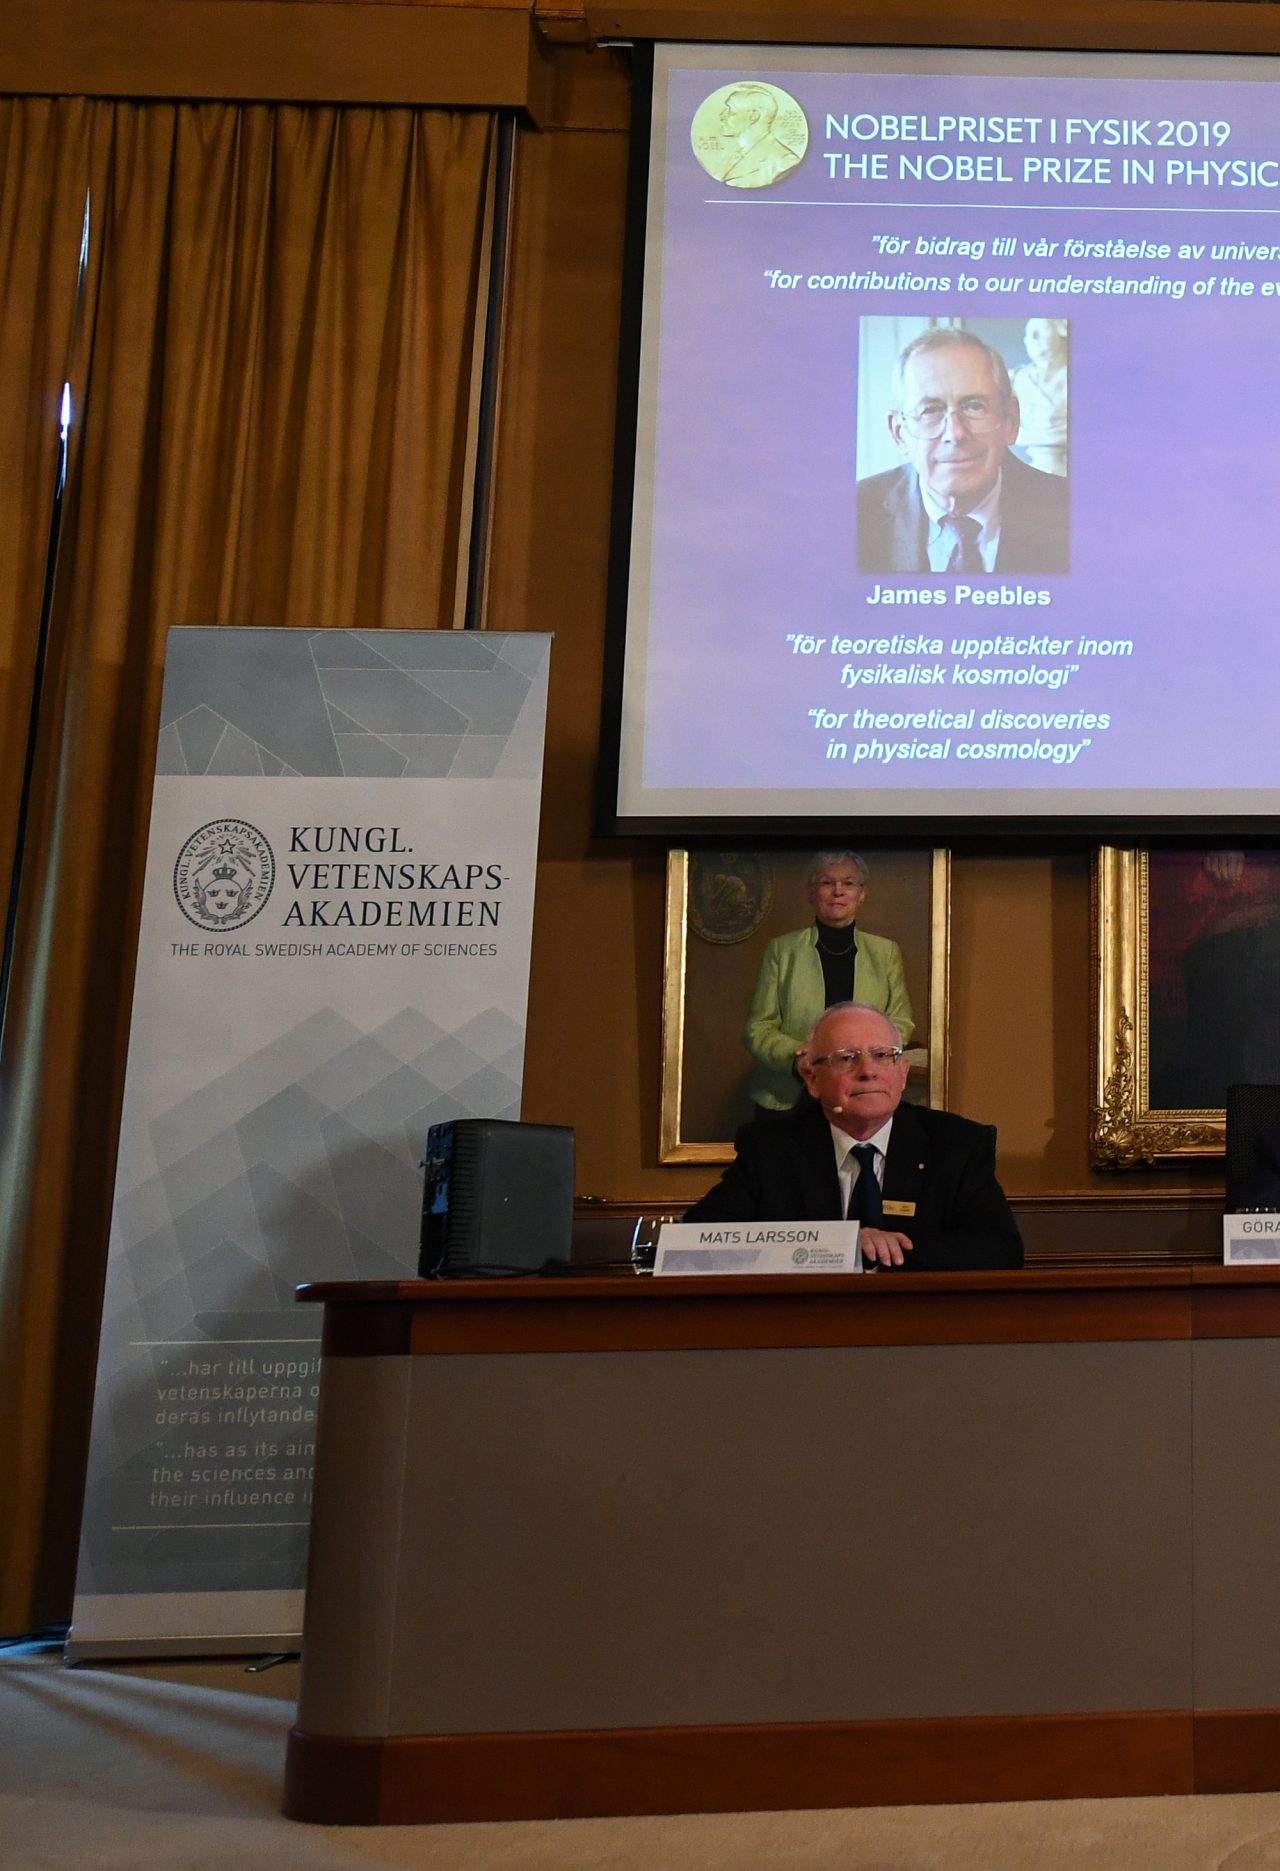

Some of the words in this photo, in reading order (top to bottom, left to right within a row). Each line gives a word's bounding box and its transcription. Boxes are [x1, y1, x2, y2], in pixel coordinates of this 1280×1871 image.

[826, 114, 1043, 143] NOBELPRISET
[1051, 118, 1056, 143] I
[1066, 119, 1152, 145] FYSIK
[1157, 120, 1231, 147] 2019
[823, 153, 888, 179] THE
[900, 155, 1013, 182] NOBEL
[1024, 157, 1111, 183] PRIZE
[1123, 159, 1154, 184] IN
[915, 236, 985, 260] bidrag
[992, 238, 1017, 256] till
[1023, 238, 1059, 257] vår
[1064, 239, 1171, 258] förståelse
[1178, 245, 1206, 259] av
[808, 271, 951, 291] contributions
[958, 273, 979, 291] to
[985, 278, 1024, 292] our
[1028, 275, 1186, 299] understanding
[1193, 277, 1217, 295] of
[1220, 277, 1255, 296] the
[866, 585, 947, 604] James
[955, 585, 1051, 605] Peebles
[831, 634, 943, 654] teoretiska
[951, 635, 1074, 659] upptäckter
[1077, 636, 1133, 655] inom
[841, 664, 947, 688] fysikalisk
[853, 709, 975, 729] theoretical
[980, 709, 1110, 729] discoveries
[826, 738, 847, 759] in
[853, 738, 951, 764] physical
[289, 827, 413, 852] KUNGL.
[287, 864, 510, 890] VETENSKAPS-
[281, 901, 501, 926] AKADEMIEN
[170, 943, 200, 956] THE
[204, 943, 250, 956] ROYAL
[255, 943, 322, 956] SWEDISH
[326, 943, 397, 956] ACADEMY
[401, 943, 420, 956] OF
[424, 943, 497, 956] SCIENCES
[700, 1231, 741, 1243] MATS
[746, 1230, 819, 1243] LARSSON
[228, 1359, 256, 1375] till
[156, 1385, 302, 1402] vetenskaperna
[155, 1409, 210, 1425] deras
[218, 1407, 314, 1427] inflytande
[225, 1445, 247, 1457] as
[255, 1441, 278, 1457] its
[152, 1467, 183, 1482] the
[190, 1467, 276, 1482] sciences
[150, 1491, 197, 1507] their
[205, 1490, 295, 1505] influence
